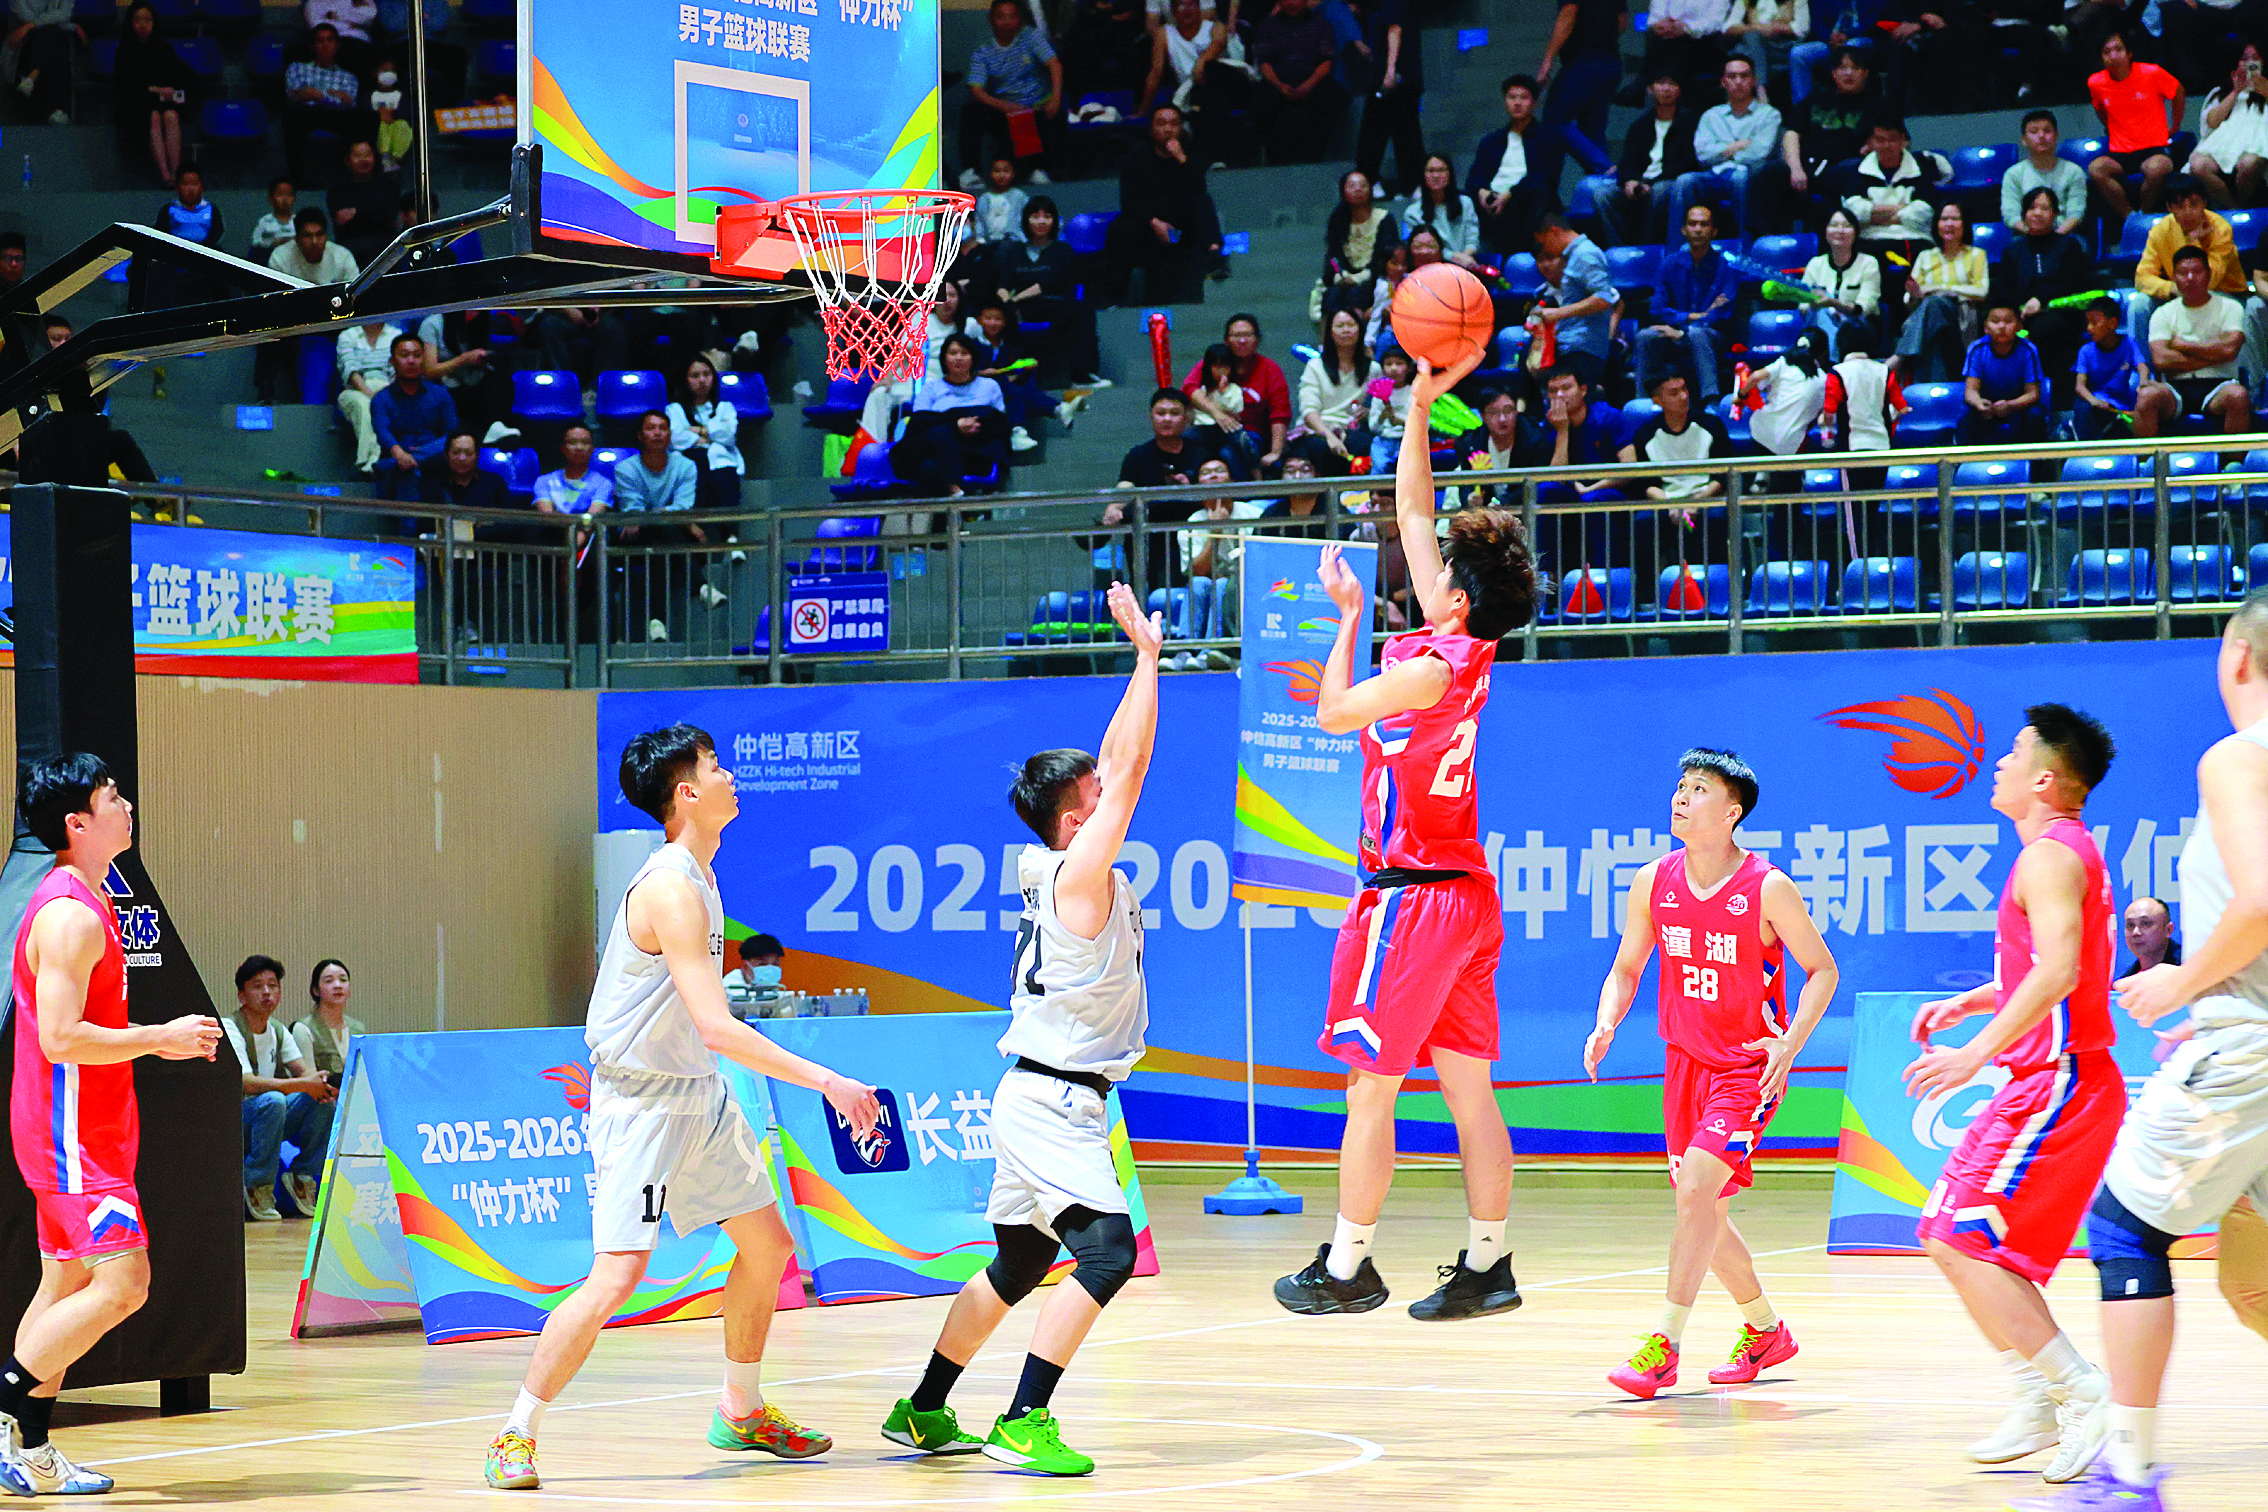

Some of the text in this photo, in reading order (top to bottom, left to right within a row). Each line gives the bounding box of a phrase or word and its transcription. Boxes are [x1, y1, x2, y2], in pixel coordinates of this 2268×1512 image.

[679, 4, 811, 62] 男子篮球联赛
[131, 563, 335, 645] 篮球联赛
[1262, 712, 1321, 729] 2025-20
[733, 731, 861, 762] 仲恺高新区
[733, 763, 861, 778] HZZK Hi-tech Industrial
[733, 778, 839, 794] Development Zone
[128, 954, 161, 966] CULTURE
[1682, 964, 1719, 1002] 28
[452, 1173, 571, 1228] “仲力杯”
